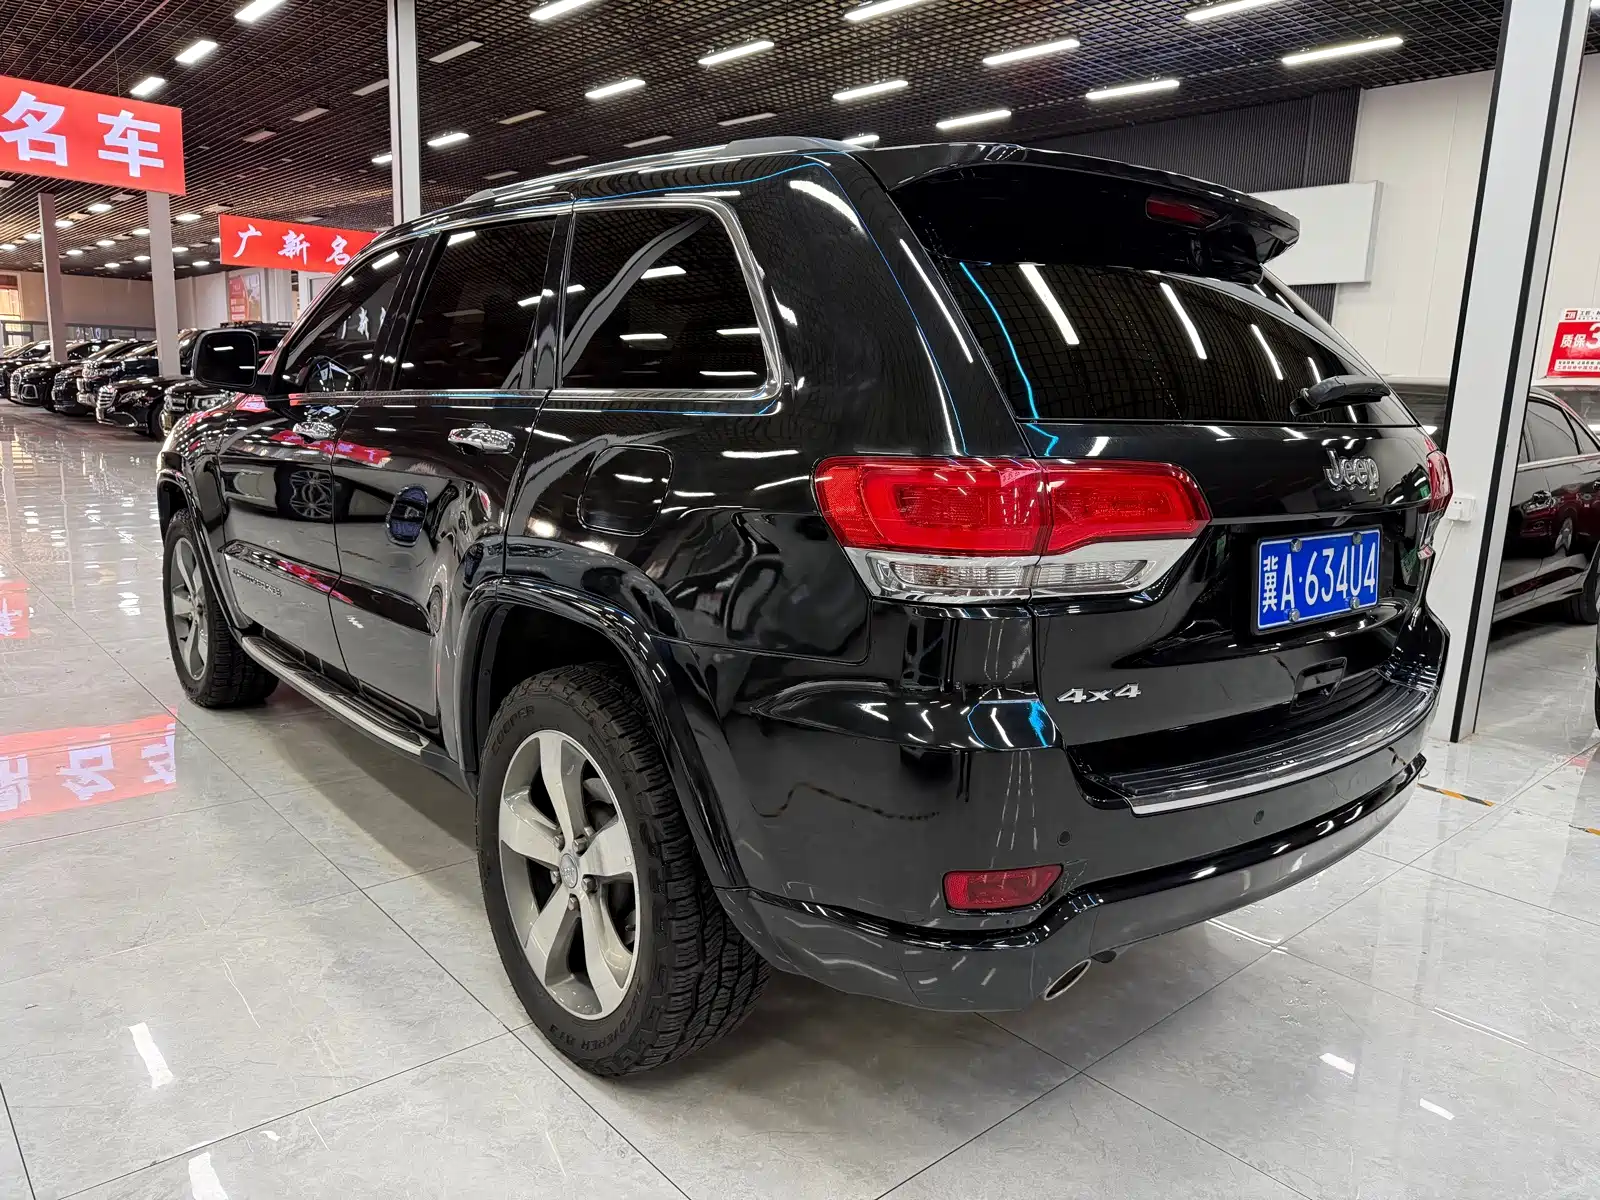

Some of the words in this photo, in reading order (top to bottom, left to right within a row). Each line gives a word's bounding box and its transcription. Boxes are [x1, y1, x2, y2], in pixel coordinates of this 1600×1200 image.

[0, 91, 164, 177] 名车
[233, 223, 351, 266] 广新名
[1323, 449, 1380, 493] Jeep
[1057, 683, 1141, 703] 4x4
[492, 704, 535, 756] COOPER
